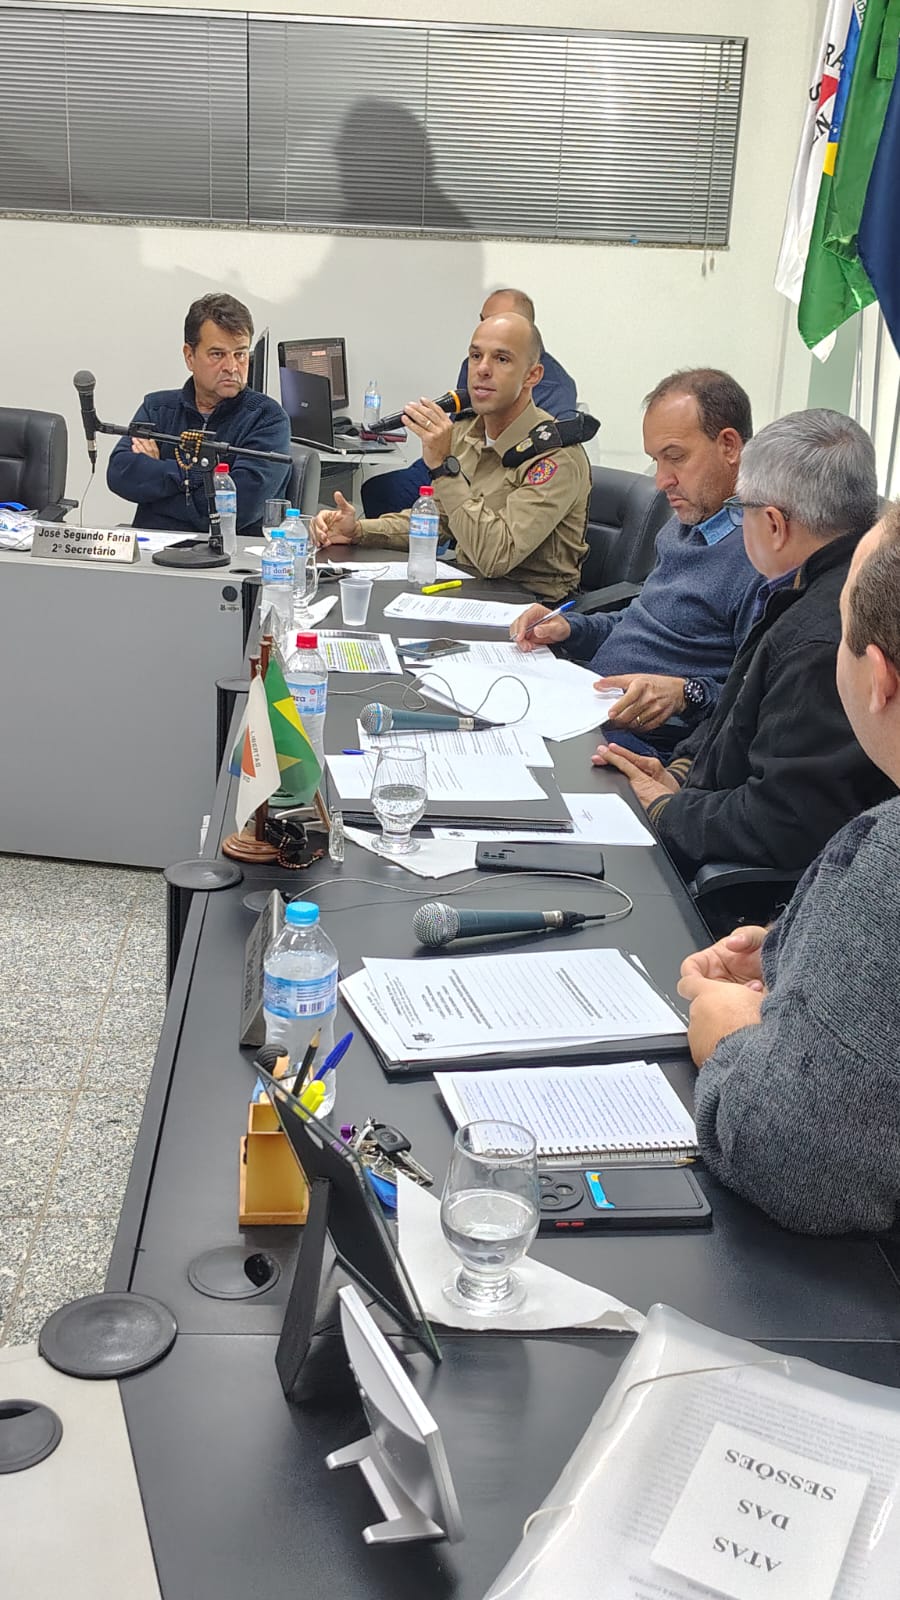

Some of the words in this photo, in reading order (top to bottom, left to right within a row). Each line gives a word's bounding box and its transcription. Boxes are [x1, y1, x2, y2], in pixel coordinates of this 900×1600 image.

[38, 527, 60, 538] José
[63, 529, 104, 542] Segundo
[106, 532, 131, 543] Faria
[64, 544, 116, 556] Secretário
[725, 1448, 837, 1502] SESSÕES
[737, 1498, 790, 1531] DAS
[712, 1535, 782, 1573] ATAS
